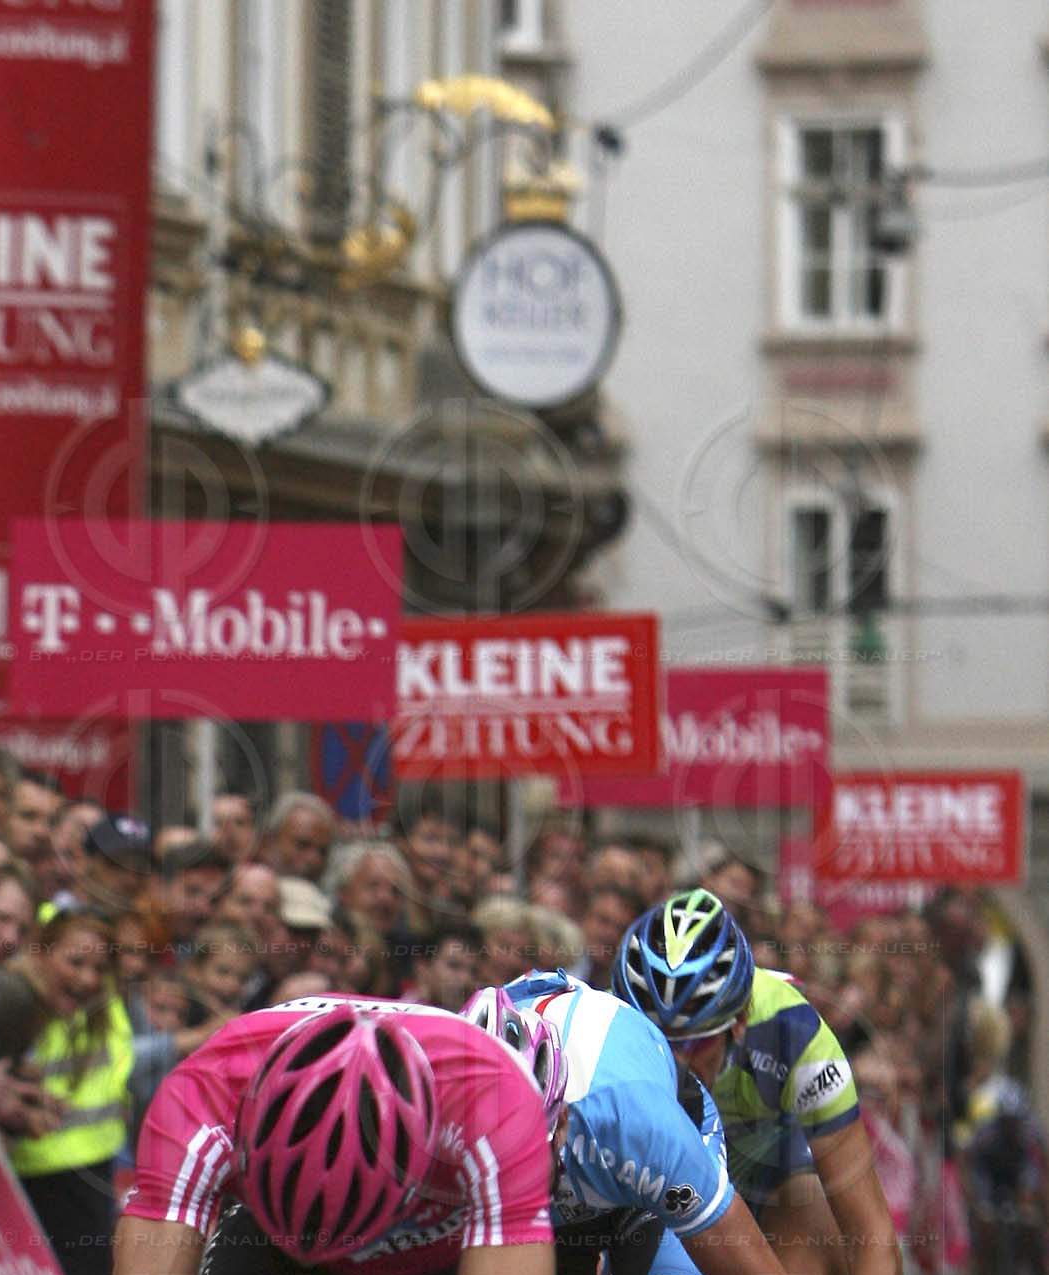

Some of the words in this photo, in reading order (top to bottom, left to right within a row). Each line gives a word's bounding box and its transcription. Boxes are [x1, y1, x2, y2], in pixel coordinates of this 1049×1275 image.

[396, 636, 632, 699] KLEINE
[392, 711, 634, 758] ZEITUNG
[834, 784, 1003, 832] KLEINE
